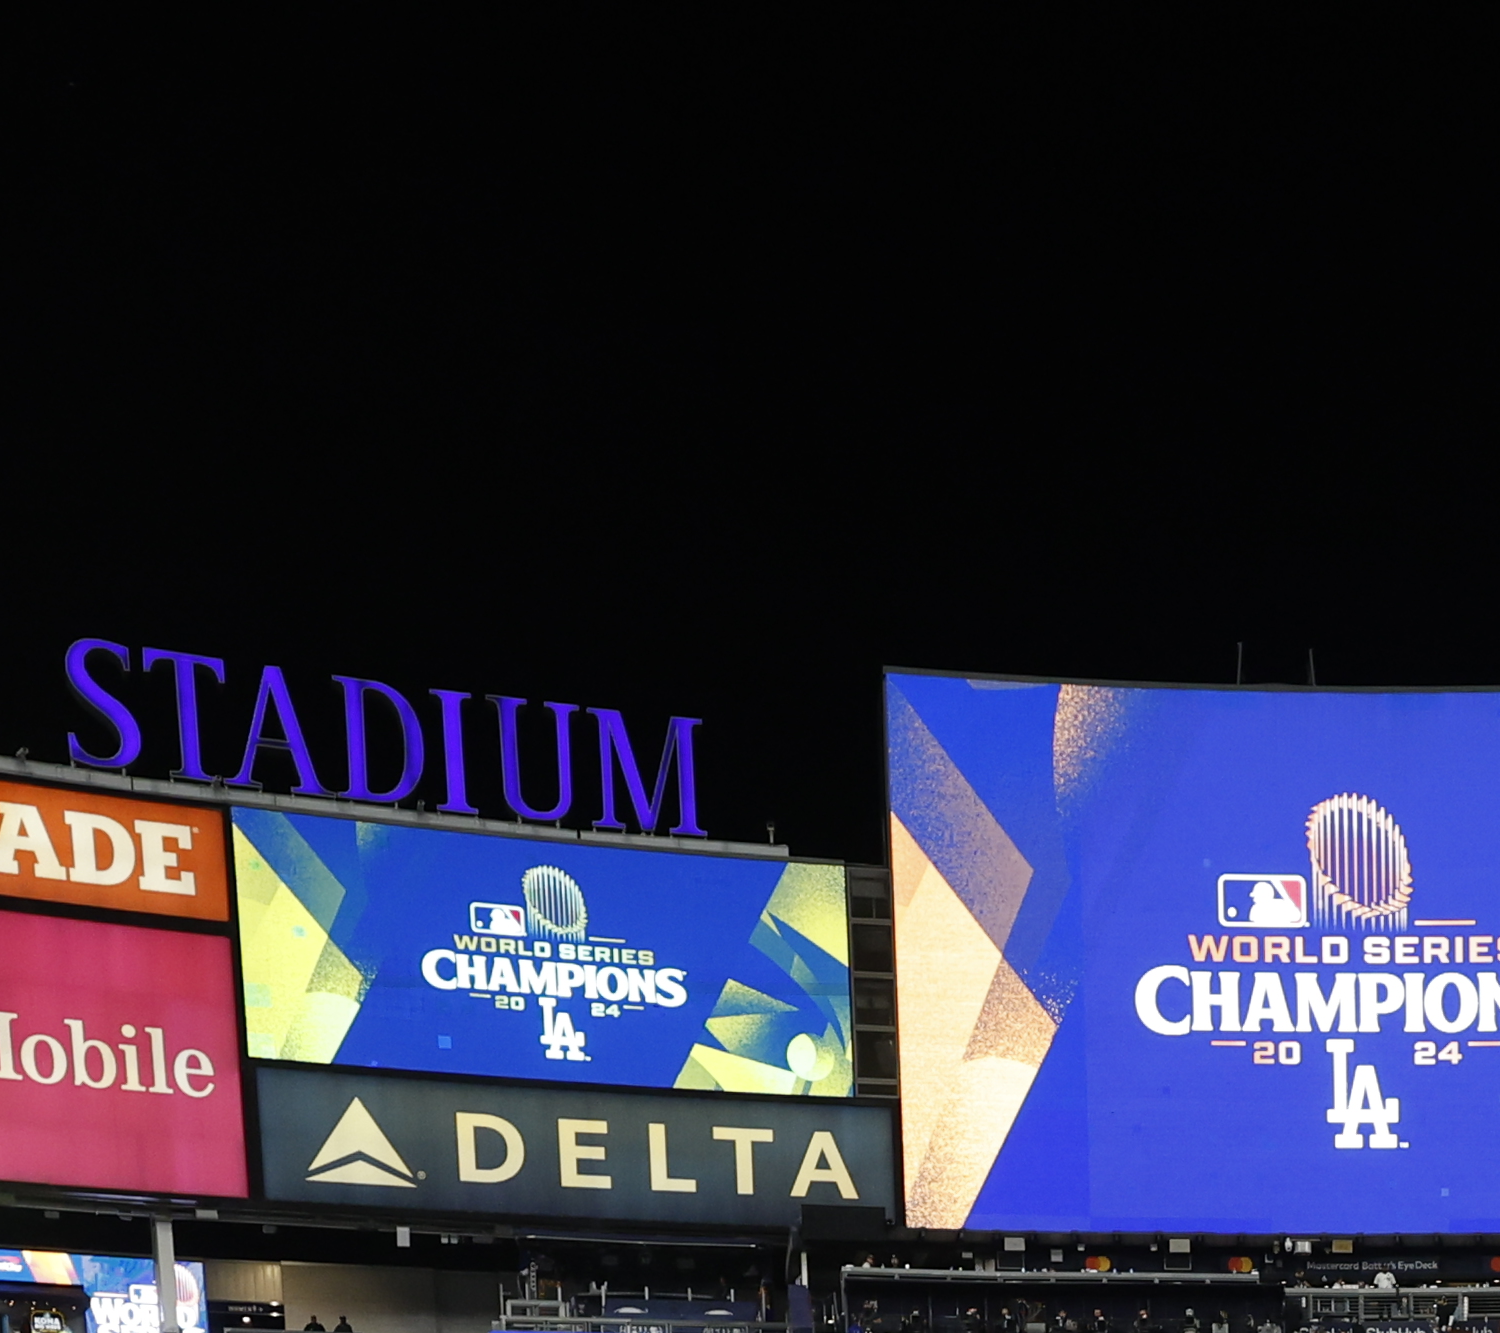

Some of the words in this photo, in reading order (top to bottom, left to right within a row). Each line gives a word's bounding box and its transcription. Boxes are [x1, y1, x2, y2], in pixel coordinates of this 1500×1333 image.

[65, 637, 708, 838] STADIUM
[421, 948, 687, 1006] CHAMPIONS
[452, 934, 551, 962] WORLD
[559, 942, 655, 966] SERIES
[1188, 935, 1350, 964] WORLD
[494, 995, 525, 1010] 20
[591, 1002, 621, 1019] 24
[538, 998, 587, 1062] LA
[1253, 1044, 1300, 1065] 20
[1413, 1042, 1462, 1065] 24
[1327, 1039, 1399, 1149] LA
[455, 1111, 859, 1200] DELTA
